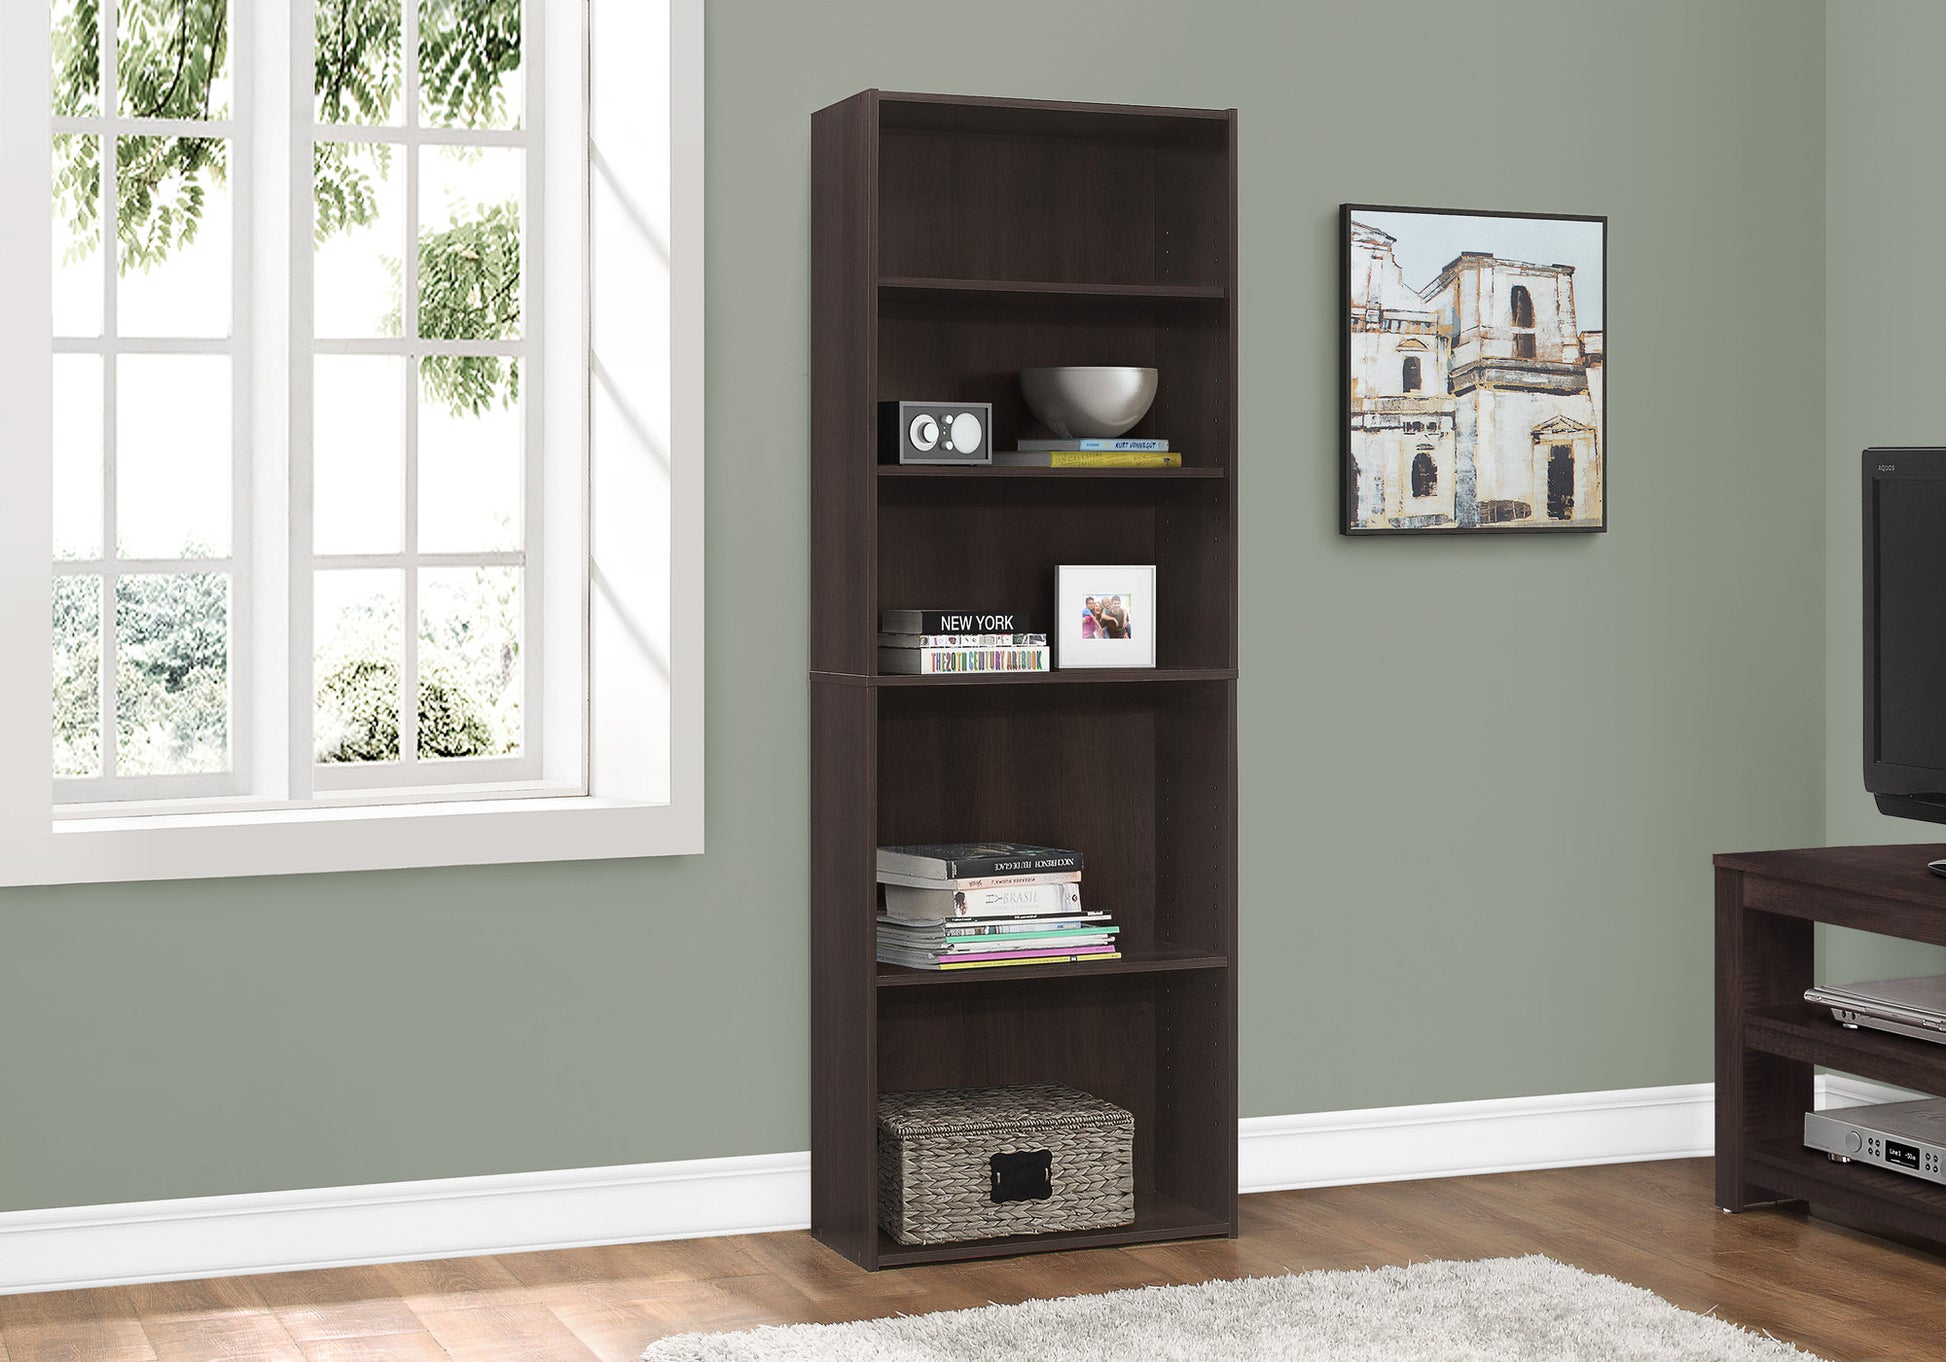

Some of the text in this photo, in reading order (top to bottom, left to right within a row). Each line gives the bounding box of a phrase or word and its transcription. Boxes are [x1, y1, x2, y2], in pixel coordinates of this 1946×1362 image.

[941, 615, 1014, 631] NEW YORK
[968, 651, 1005, 672] CENTURY
[1002, 891, 1039, 904] BRASIL
